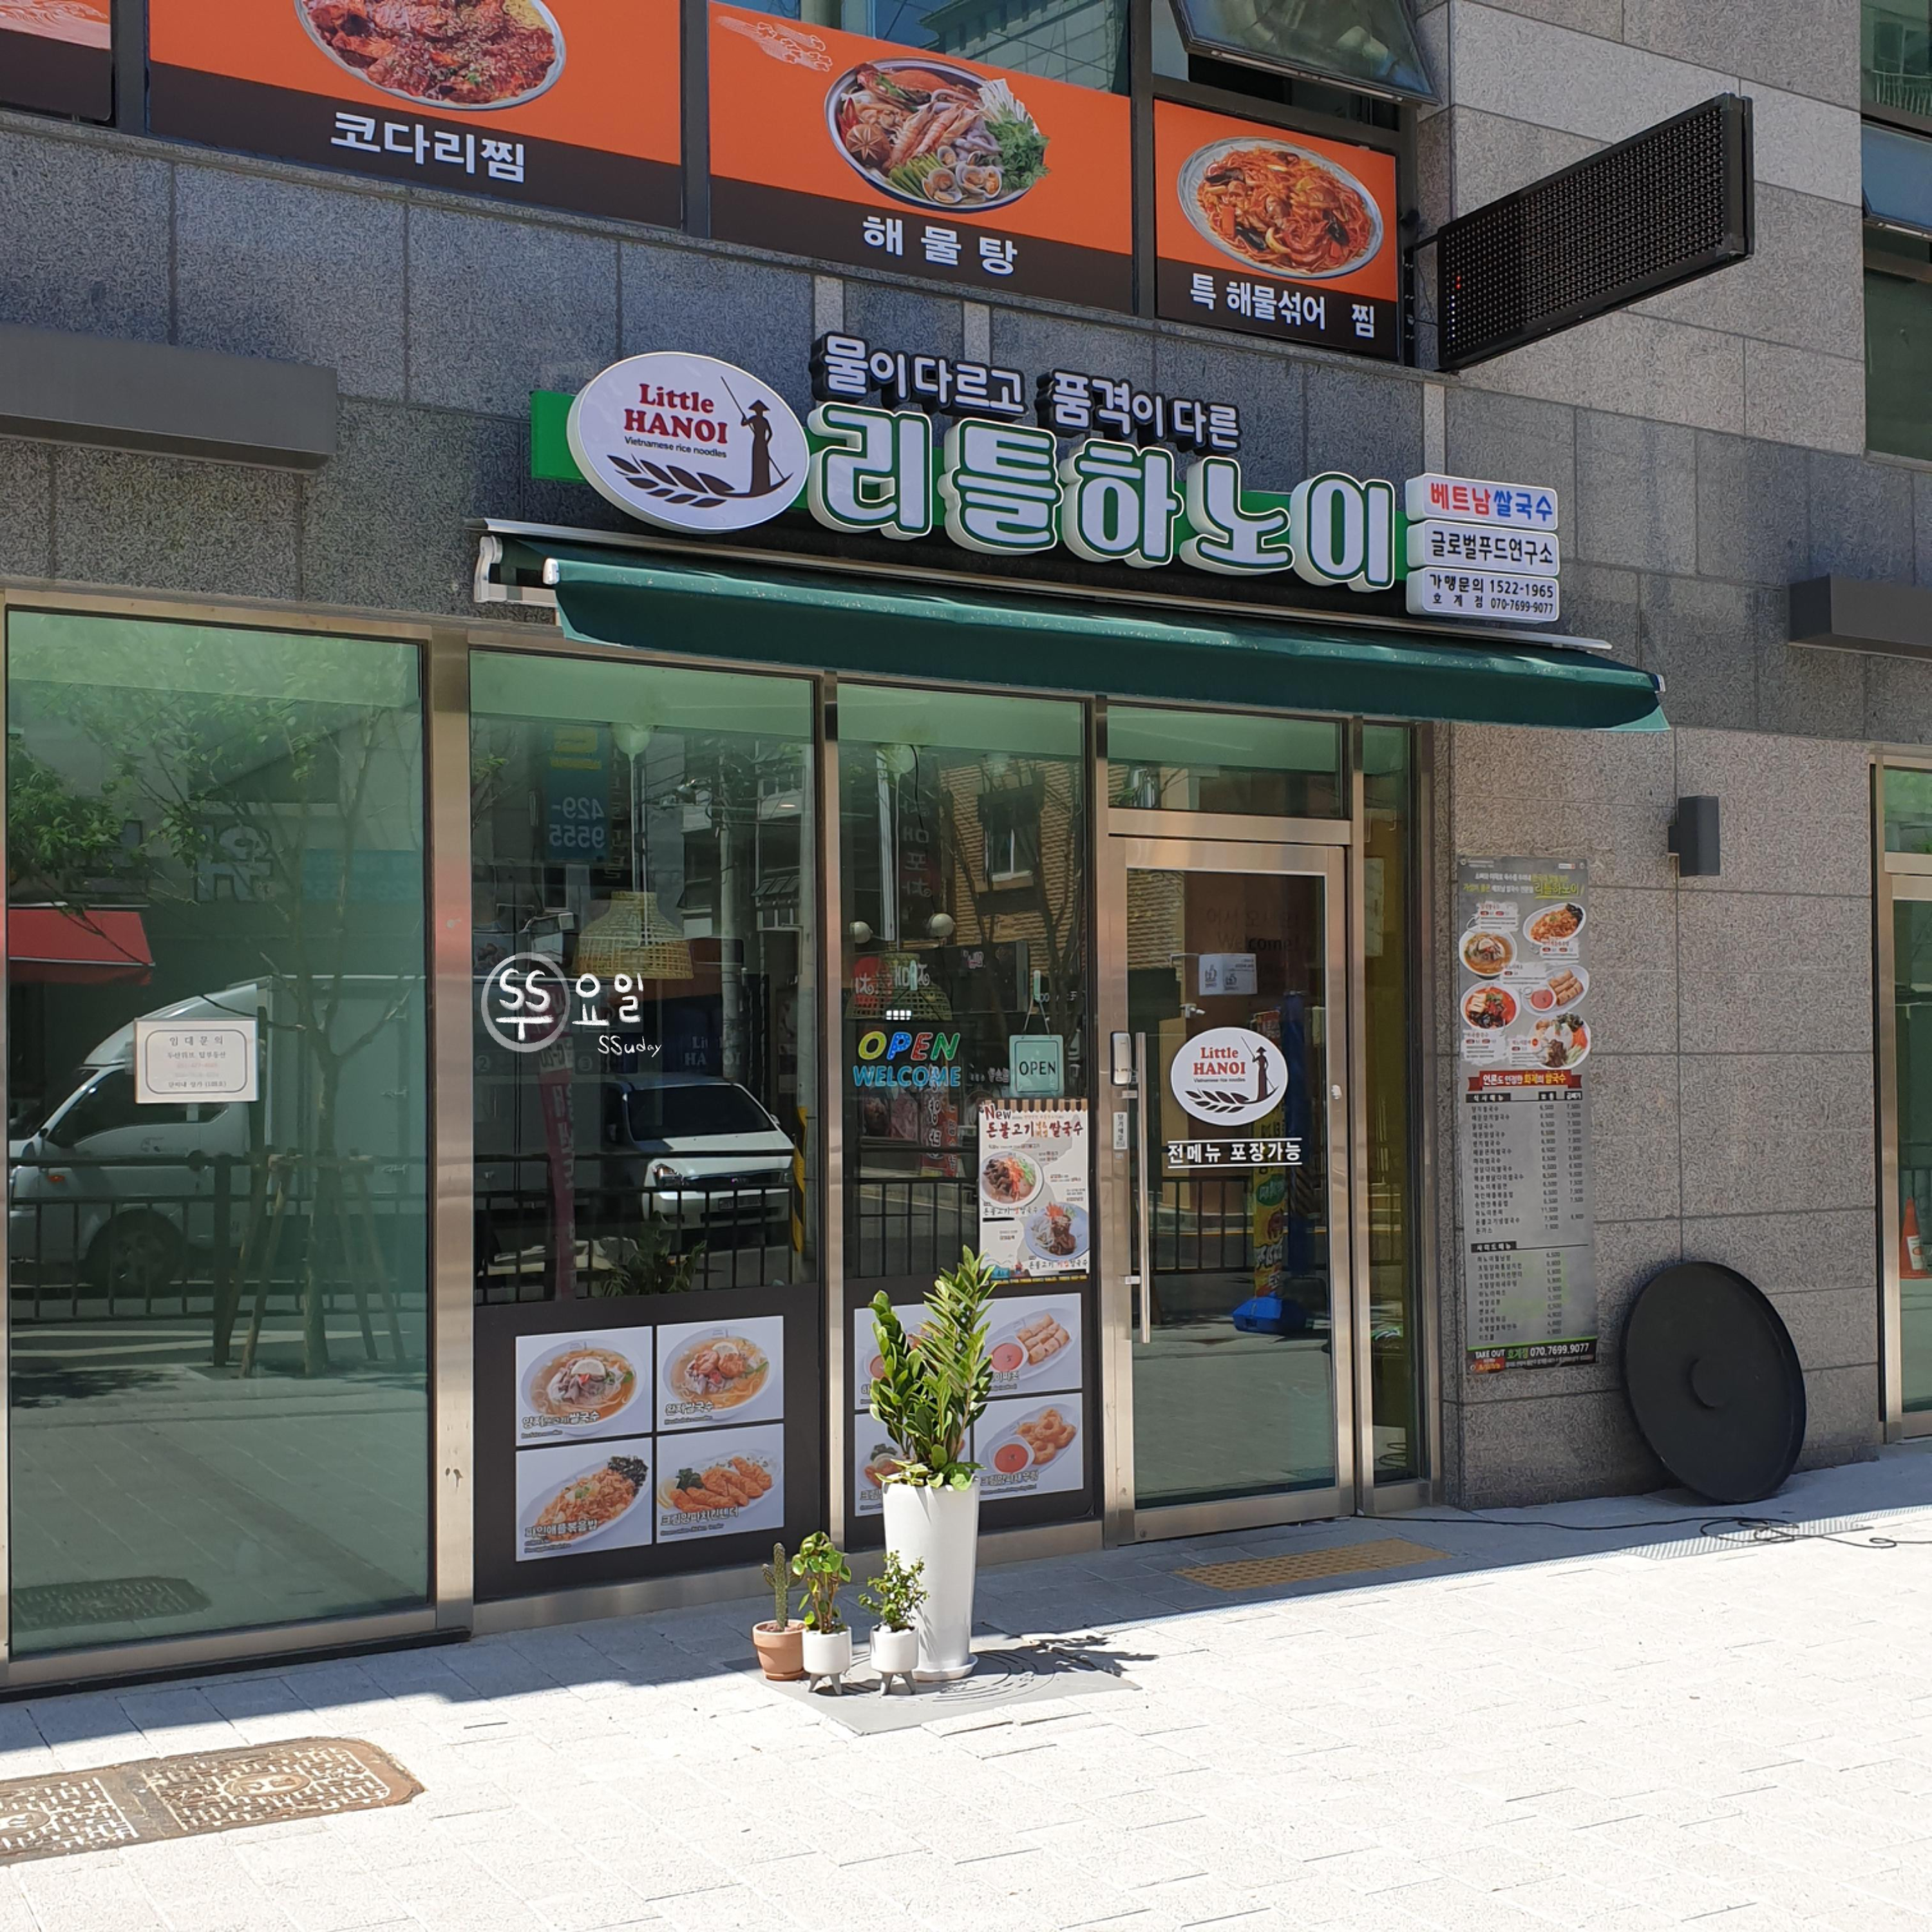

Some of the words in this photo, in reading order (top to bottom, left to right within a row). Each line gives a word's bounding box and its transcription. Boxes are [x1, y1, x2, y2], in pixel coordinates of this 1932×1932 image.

[330, 111, 526, 184] 코다리찜
[1189, 273, 1217, 311] 특
[1226, 282, 1327, 331] 해물섞어
[1351, 303, 1376, 339] 찜
[639, 383, 714, 413] Little
[623, 408, 728, 444] HANOI
[624, 436, 674, 451] Vietnamese
[676, 444, 692, 454] rice
[694, 446, 728, 459] noodles
[815, 401, 1395, 591] 리틀하노이
[1430, 530, 1553, 566] 글로벌푸드연구소
[1429, 574, 1484, 593] 가맹문의
[1489, 579, 1553, 598] 1522-1965
[1490, 598, 1553, 614] 070-7699-9077
[857, 1030, 961, 1061] OPEN
[1200, 1046, 1238, 1059] Little
[853, 1064, 962, 1088] WELCOME
[1019, 1060, 1057, 1076] OPEN
[1193, 1061, 1246, 1075] HANOI
[984, 1105, 1011, 1121] New
[985, 1120, 1034, 1139] 돈불고기
[1049, 1120, 1084, 1138] 쌀국수
[1168, 1142, 1222, 1164] 전메뉴
[1230, 1141, 1302, 1162] 포장가능
[1491, 1349, 1506, 1358] OUT
[1530, 1343, 1590, 1357] 070.7699.9077
